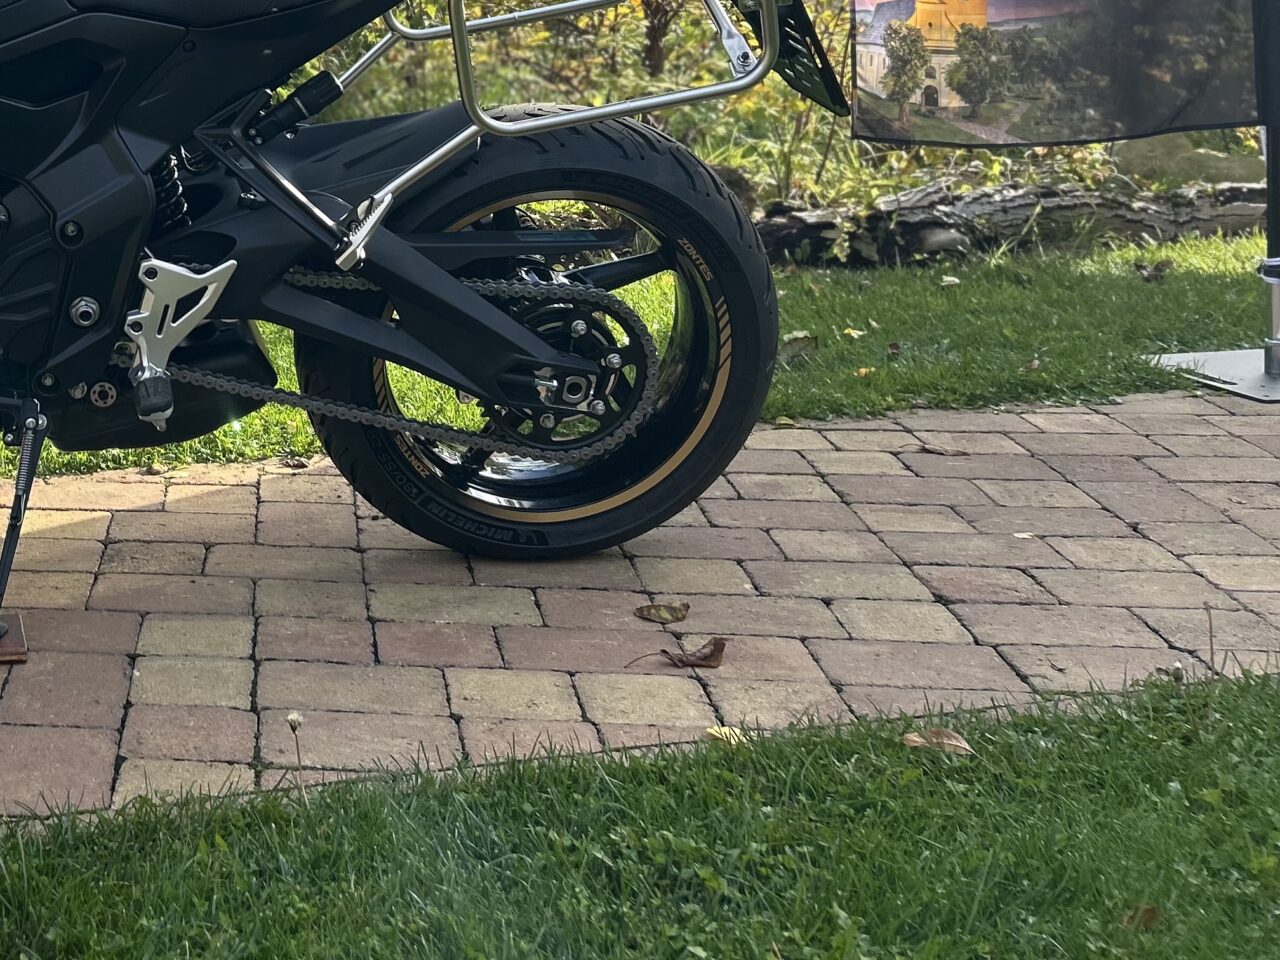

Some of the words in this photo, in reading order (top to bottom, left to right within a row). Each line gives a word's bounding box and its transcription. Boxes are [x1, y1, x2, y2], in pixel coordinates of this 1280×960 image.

[677, 236, 714, 282] ZONTES
[393, 433, 431, 480] ZONTES
[425, 499, 514, 542] MICHELIN
